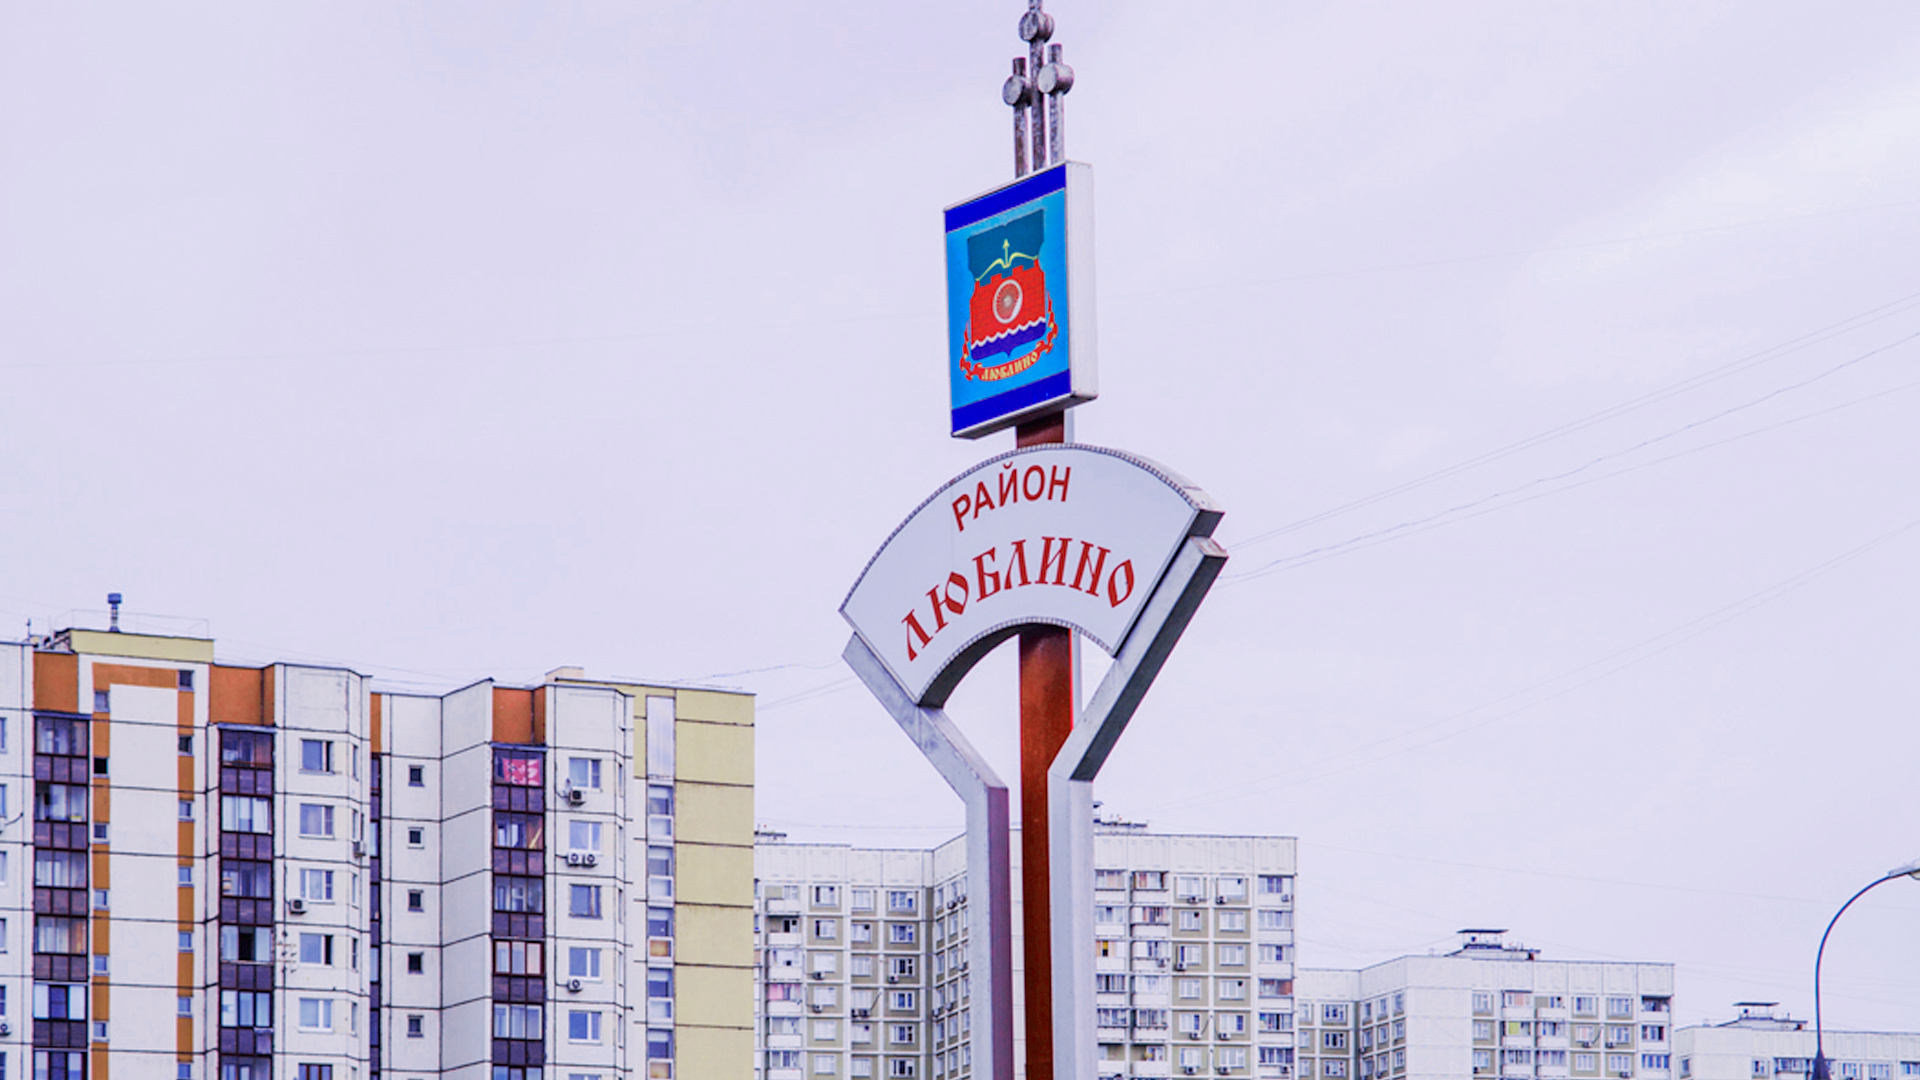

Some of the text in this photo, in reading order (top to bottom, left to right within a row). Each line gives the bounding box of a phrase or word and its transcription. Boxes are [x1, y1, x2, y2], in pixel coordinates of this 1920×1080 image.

[981, 352, 1038, 380] ЛЮБЛИНО
[952, 462, 1071, 532] РАЙОН
[902, 536, 1135, 662] ЛЮБЛИНО
